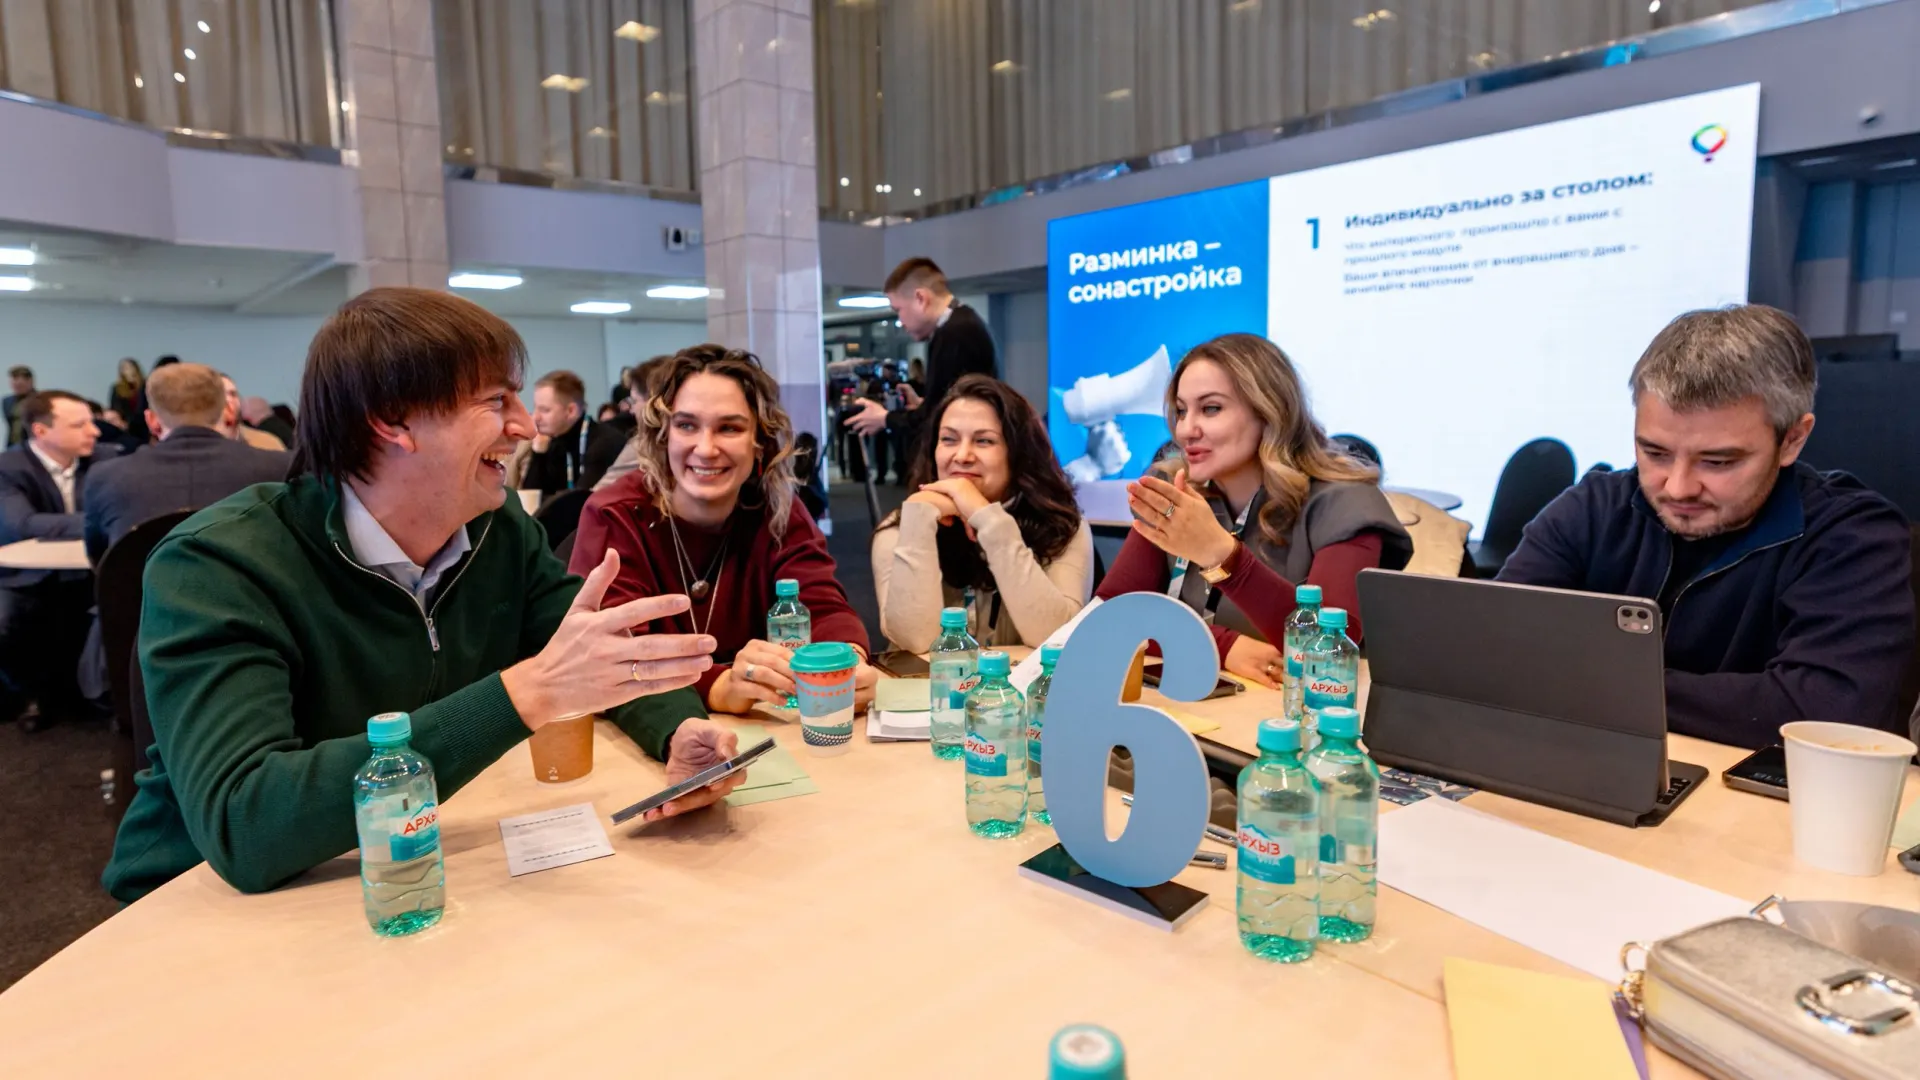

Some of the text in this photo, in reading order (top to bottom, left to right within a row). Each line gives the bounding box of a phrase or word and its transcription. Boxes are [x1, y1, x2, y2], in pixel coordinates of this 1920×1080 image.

[1345, 172, 1654, 229] Индивидуально за столом:
[1566, 210, 1609, 223] вами
[1306, 217, 1320, 250] 1
[1069, 239, 1198, 275] Разминка
[1068, 264, 1243, 304] сонастройка
[1311, 682, 1348, 694] АРХЫЗ
[1042, 591, 1220, 888] 6
